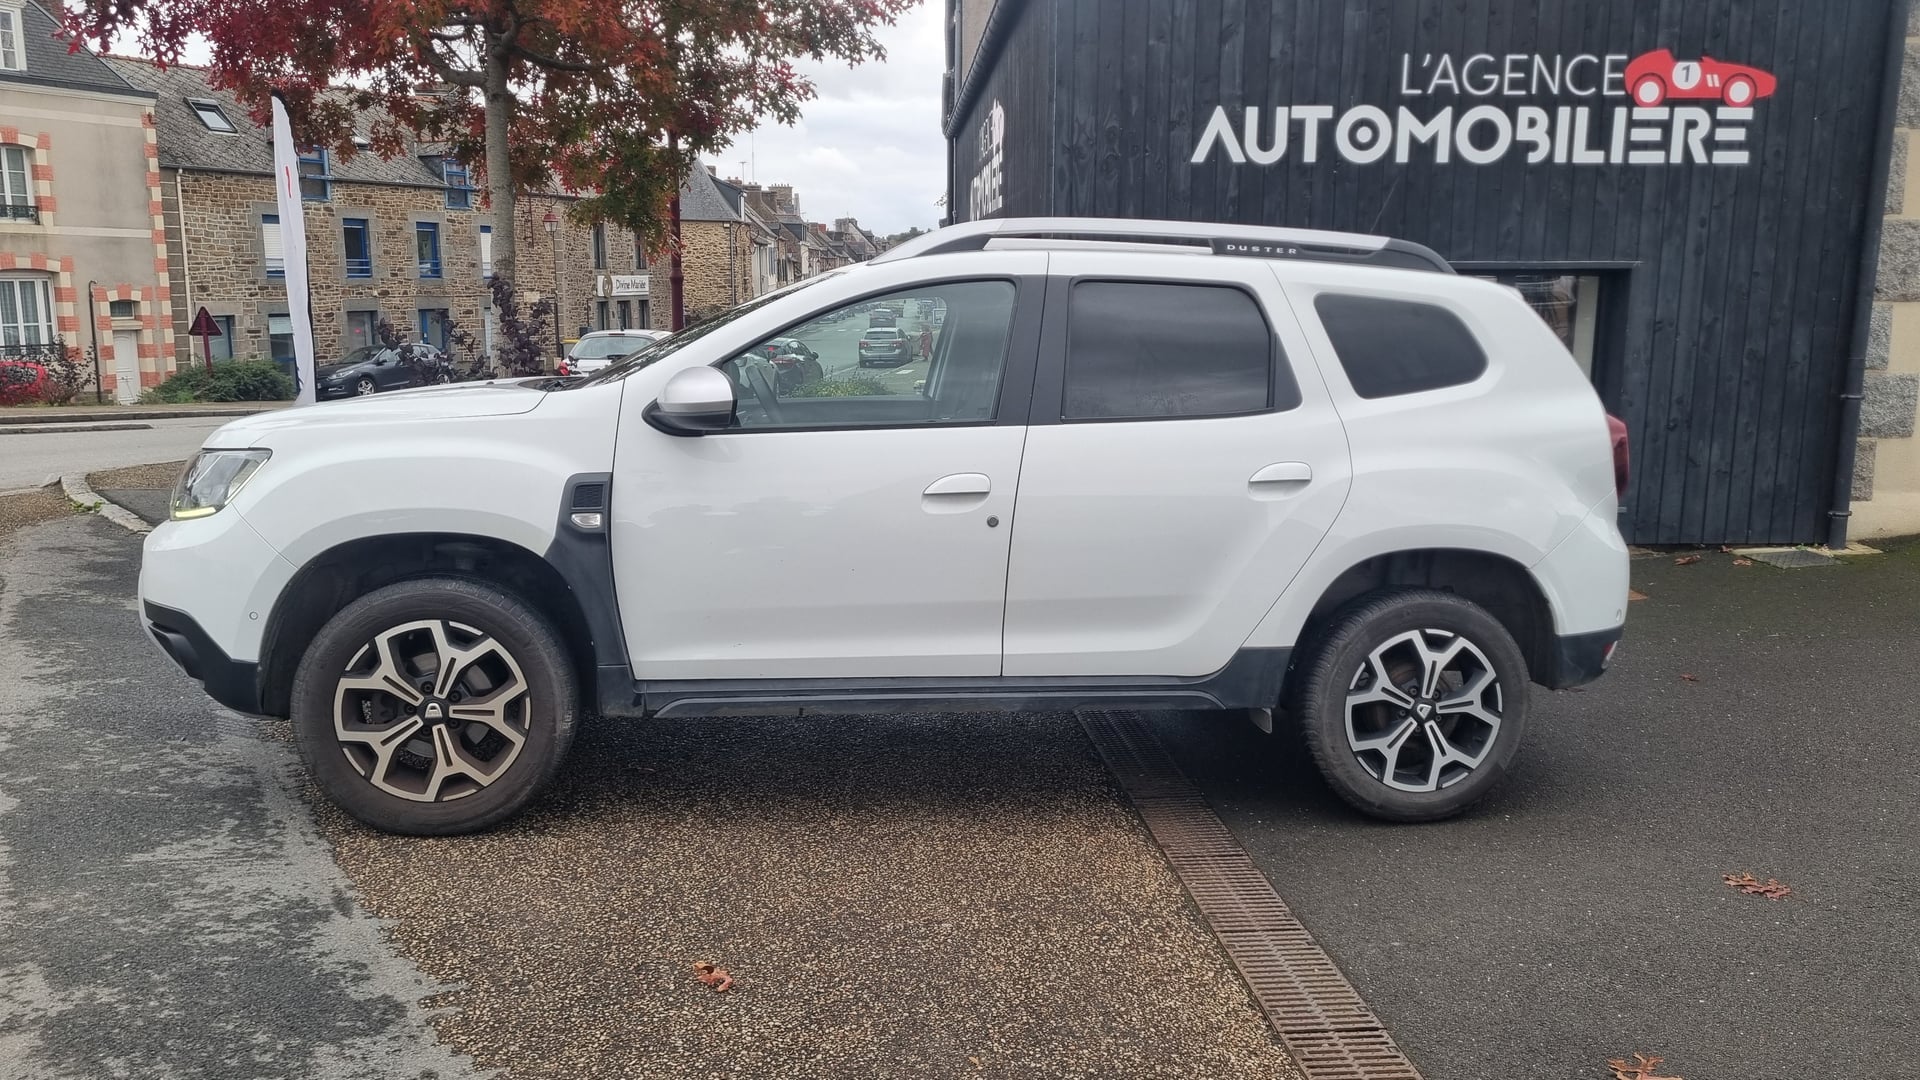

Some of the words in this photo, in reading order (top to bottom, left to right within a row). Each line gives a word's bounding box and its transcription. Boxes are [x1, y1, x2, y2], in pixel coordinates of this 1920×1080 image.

[1401, 52, 1627, 95] L'AGENCE
[1680, 64, 1691, 83] 1
[1191, 104, 1753, 164] AUTOMOBILIERE
[1226, 244, 1297, 255] DUSTER
[616, 279, 631, 289] Divine
